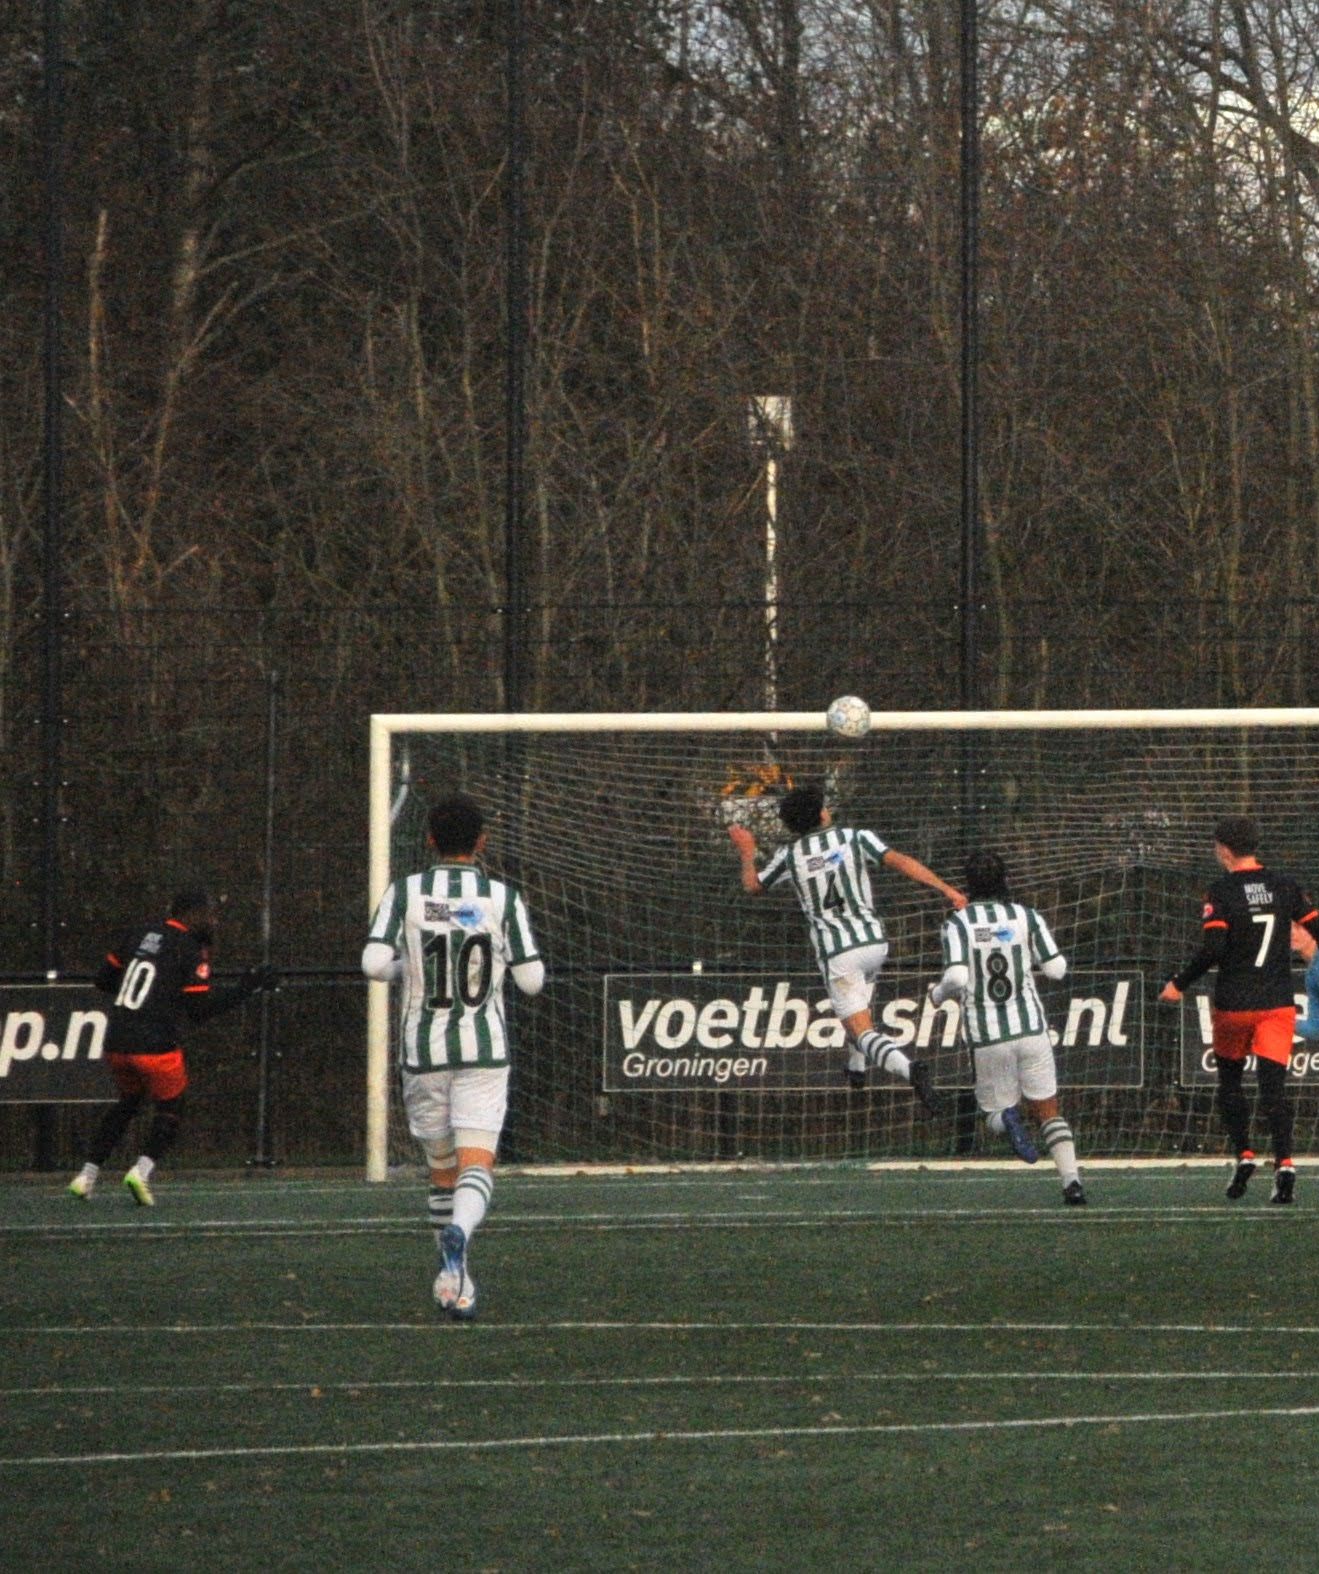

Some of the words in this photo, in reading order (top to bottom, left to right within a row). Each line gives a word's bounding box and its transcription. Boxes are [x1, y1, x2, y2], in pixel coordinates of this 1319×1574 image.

[822, 871, 846, 914] 4
[1246, 893, 1273, 905] SAFELY
[1252, 914, 1275, 967] 7
[114, 957, 156, 1010] 10
[423, 934, 493, 1009] 10
[986, 951, 1013, 1003] 8
[622, 1052, 768, 1082] Groningen
